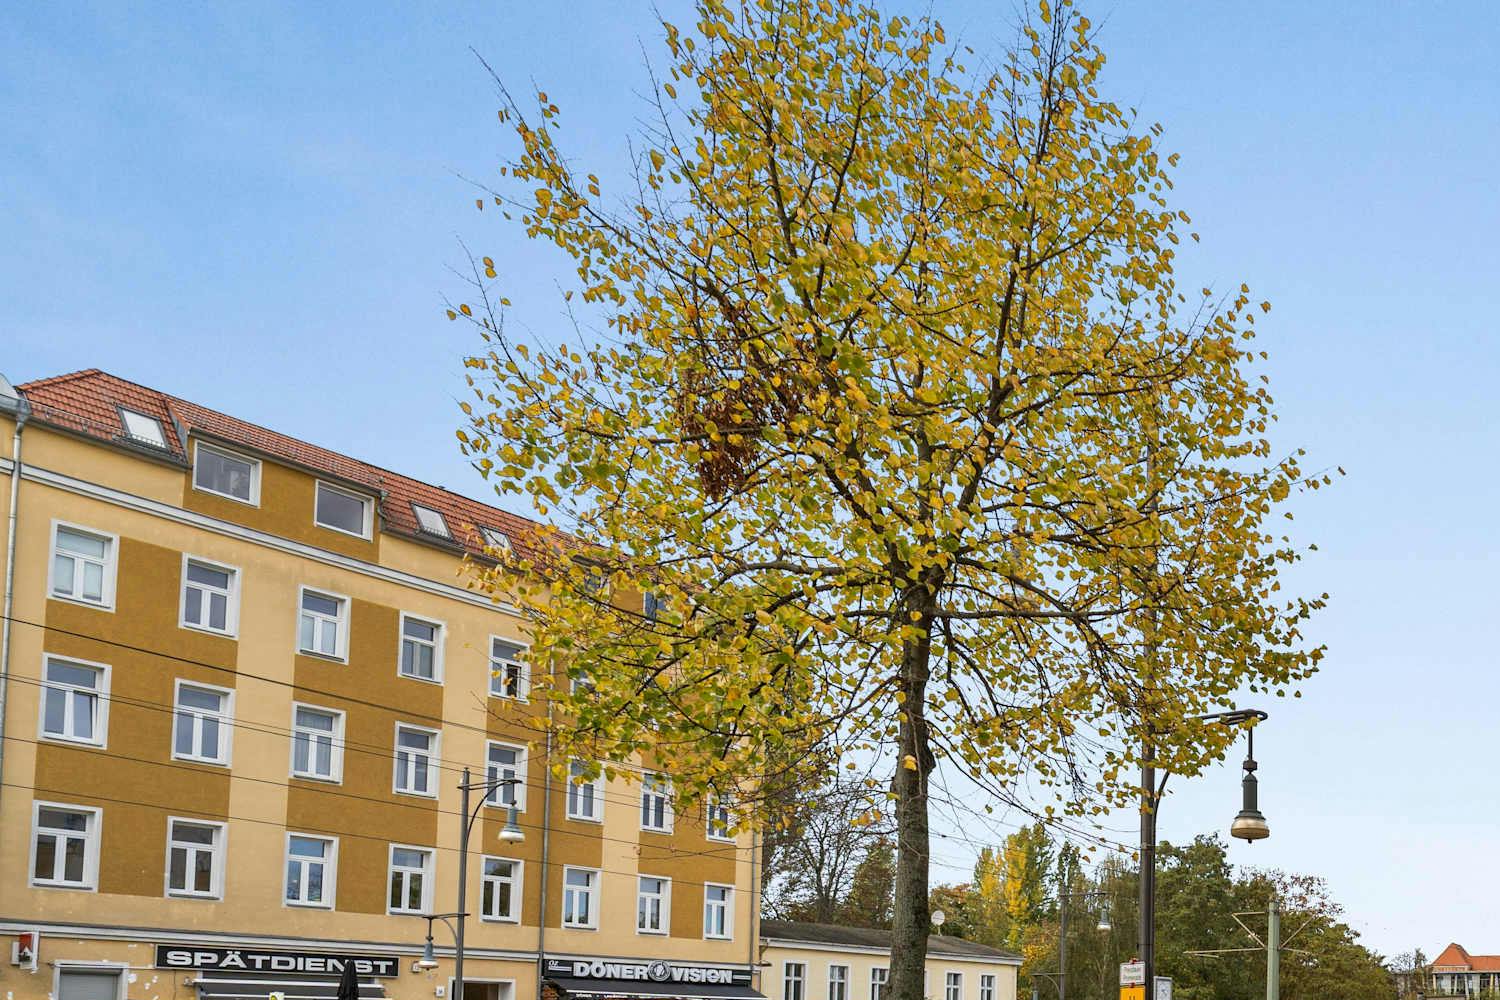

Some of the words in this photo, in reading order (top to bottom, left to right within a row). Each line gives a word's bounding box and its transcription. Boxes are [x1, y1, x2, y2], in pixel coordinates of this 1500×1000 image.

[166, 949, 393, 975] SPÄTDIENST
[573, 959, 649, 980] DÖNER
[671, 966, 733, 984] VISION
